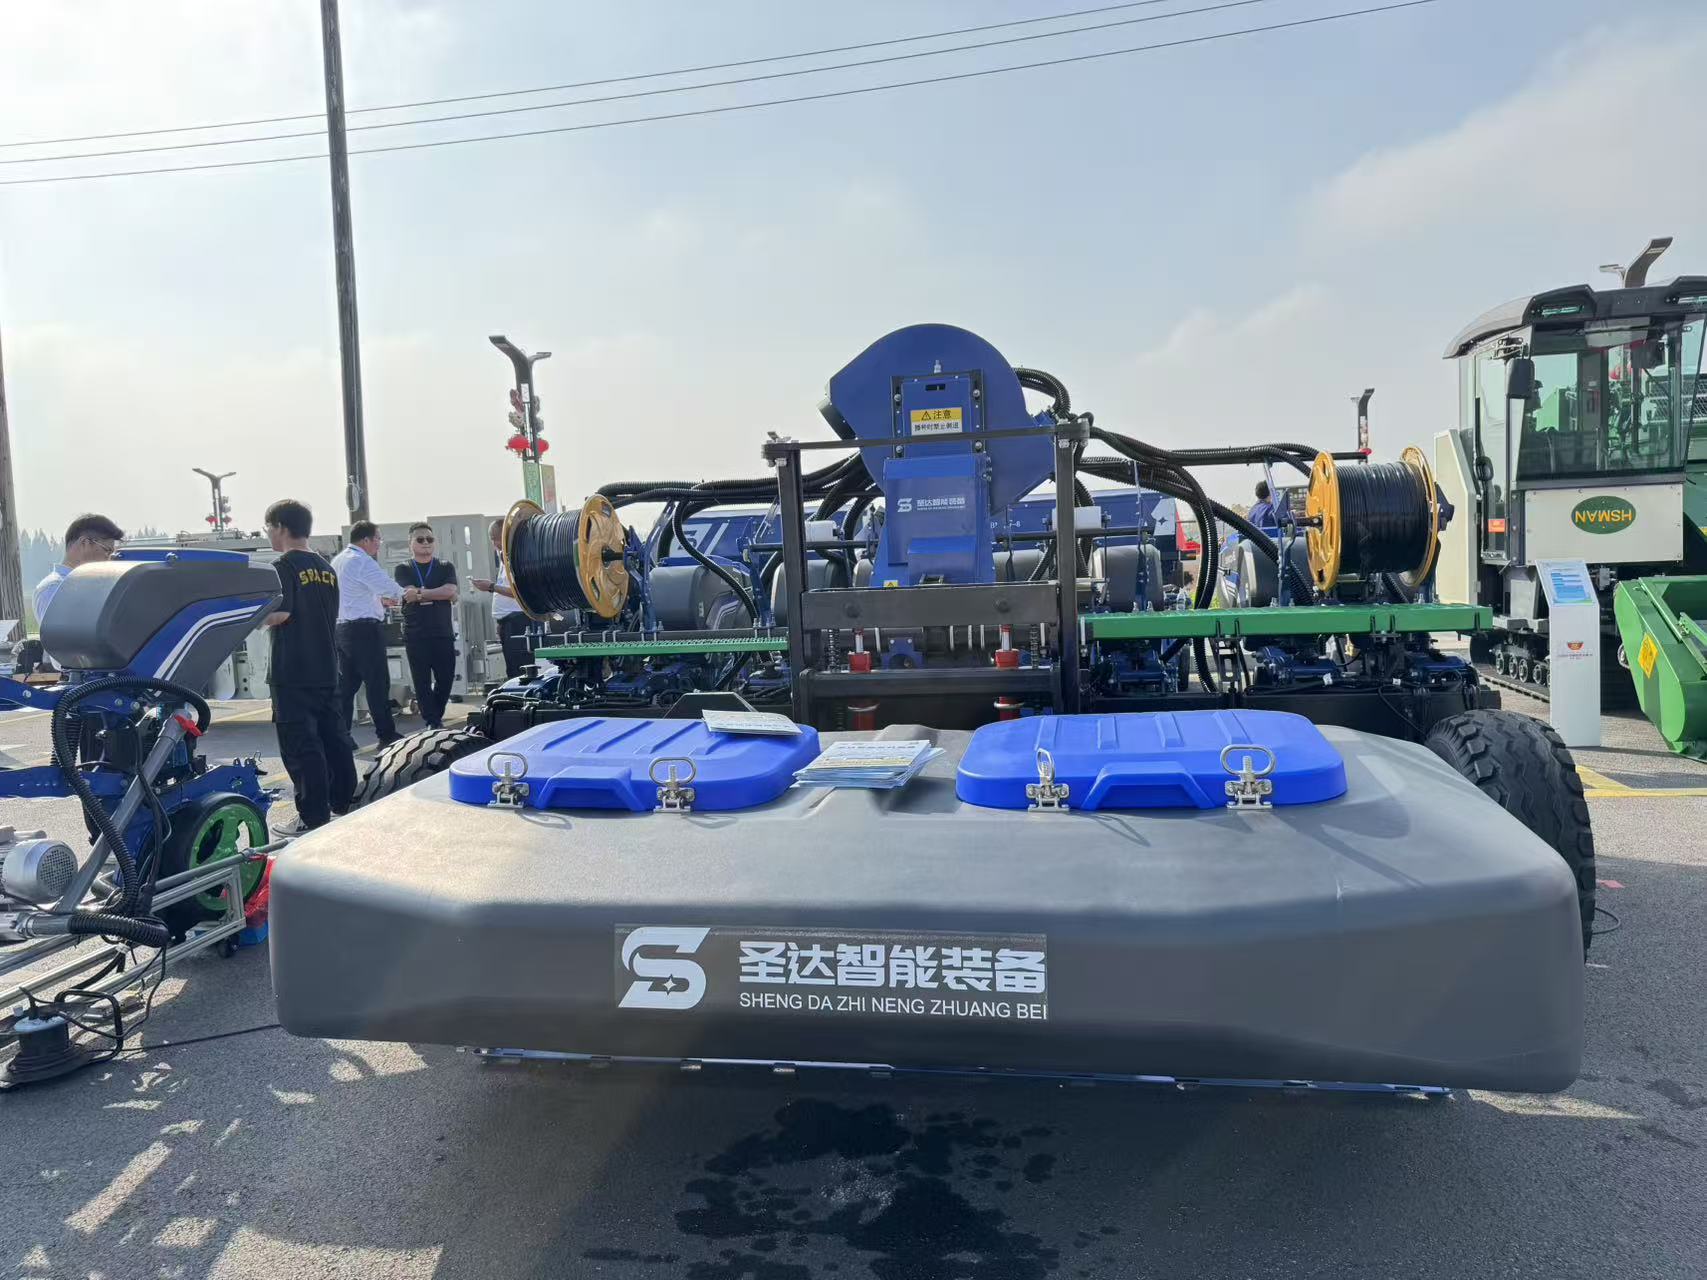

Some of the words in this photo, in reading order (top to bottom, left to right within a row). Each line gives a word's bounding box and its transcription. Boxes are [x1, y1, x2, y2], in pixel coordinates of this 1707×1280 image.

[933, 409, 951, 420] 注意
[1574, 508, 1633, 523] HSMAN
[739, 940, 1046, 994] 圣达智能装备
[739, 992, 802, 1009] SHENG
[807, 994, 834, 1011] DA
[836, 995, 866, 1012] ZHI
[871, 997, 925, 1014] NENG
[930, 999, 1011, 1018] ZHUANG
[1016, 1003, 1048, 1020] BEI
